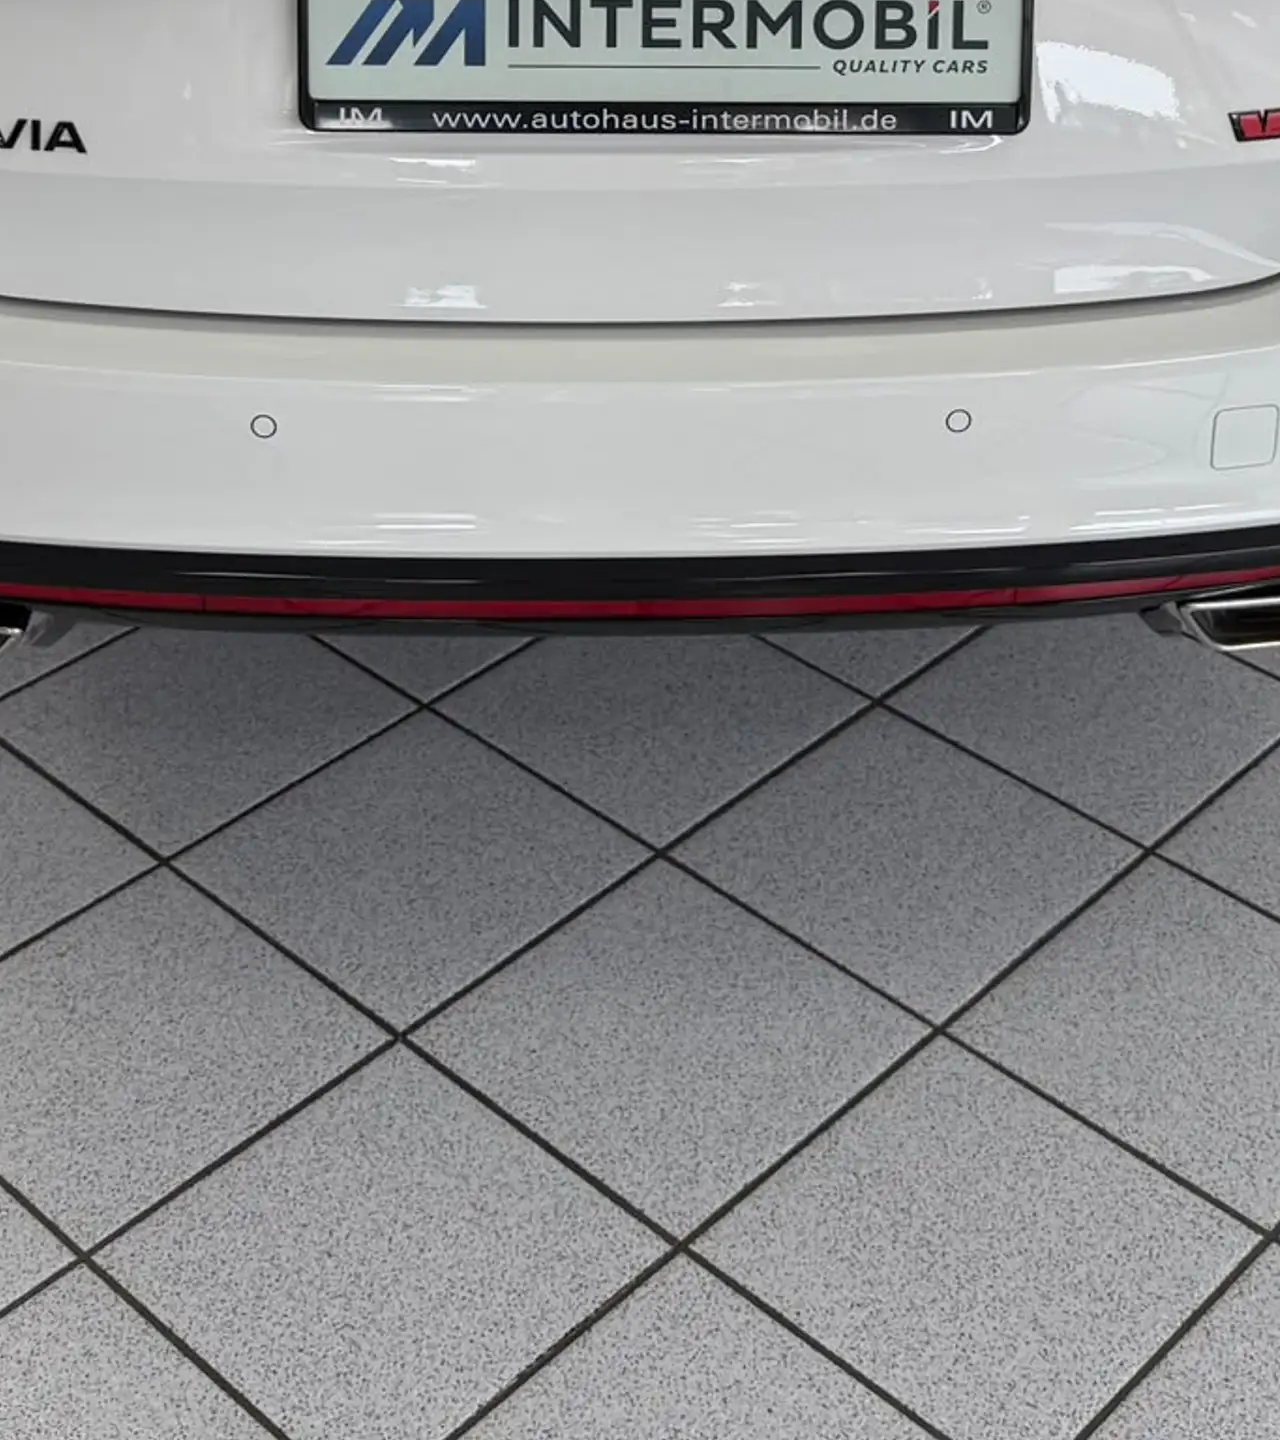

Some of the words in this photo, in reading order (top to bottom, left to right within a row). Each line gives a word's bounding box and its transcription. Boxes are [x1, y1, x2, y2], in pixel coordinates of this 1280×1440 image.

[833, 59, 925, 76] QUALITY
[932, 59, 988, 75] CARS
[432, 109, 898, 131] www.autohaus-intermobil.de
[950, 110, 993, 129] IM
